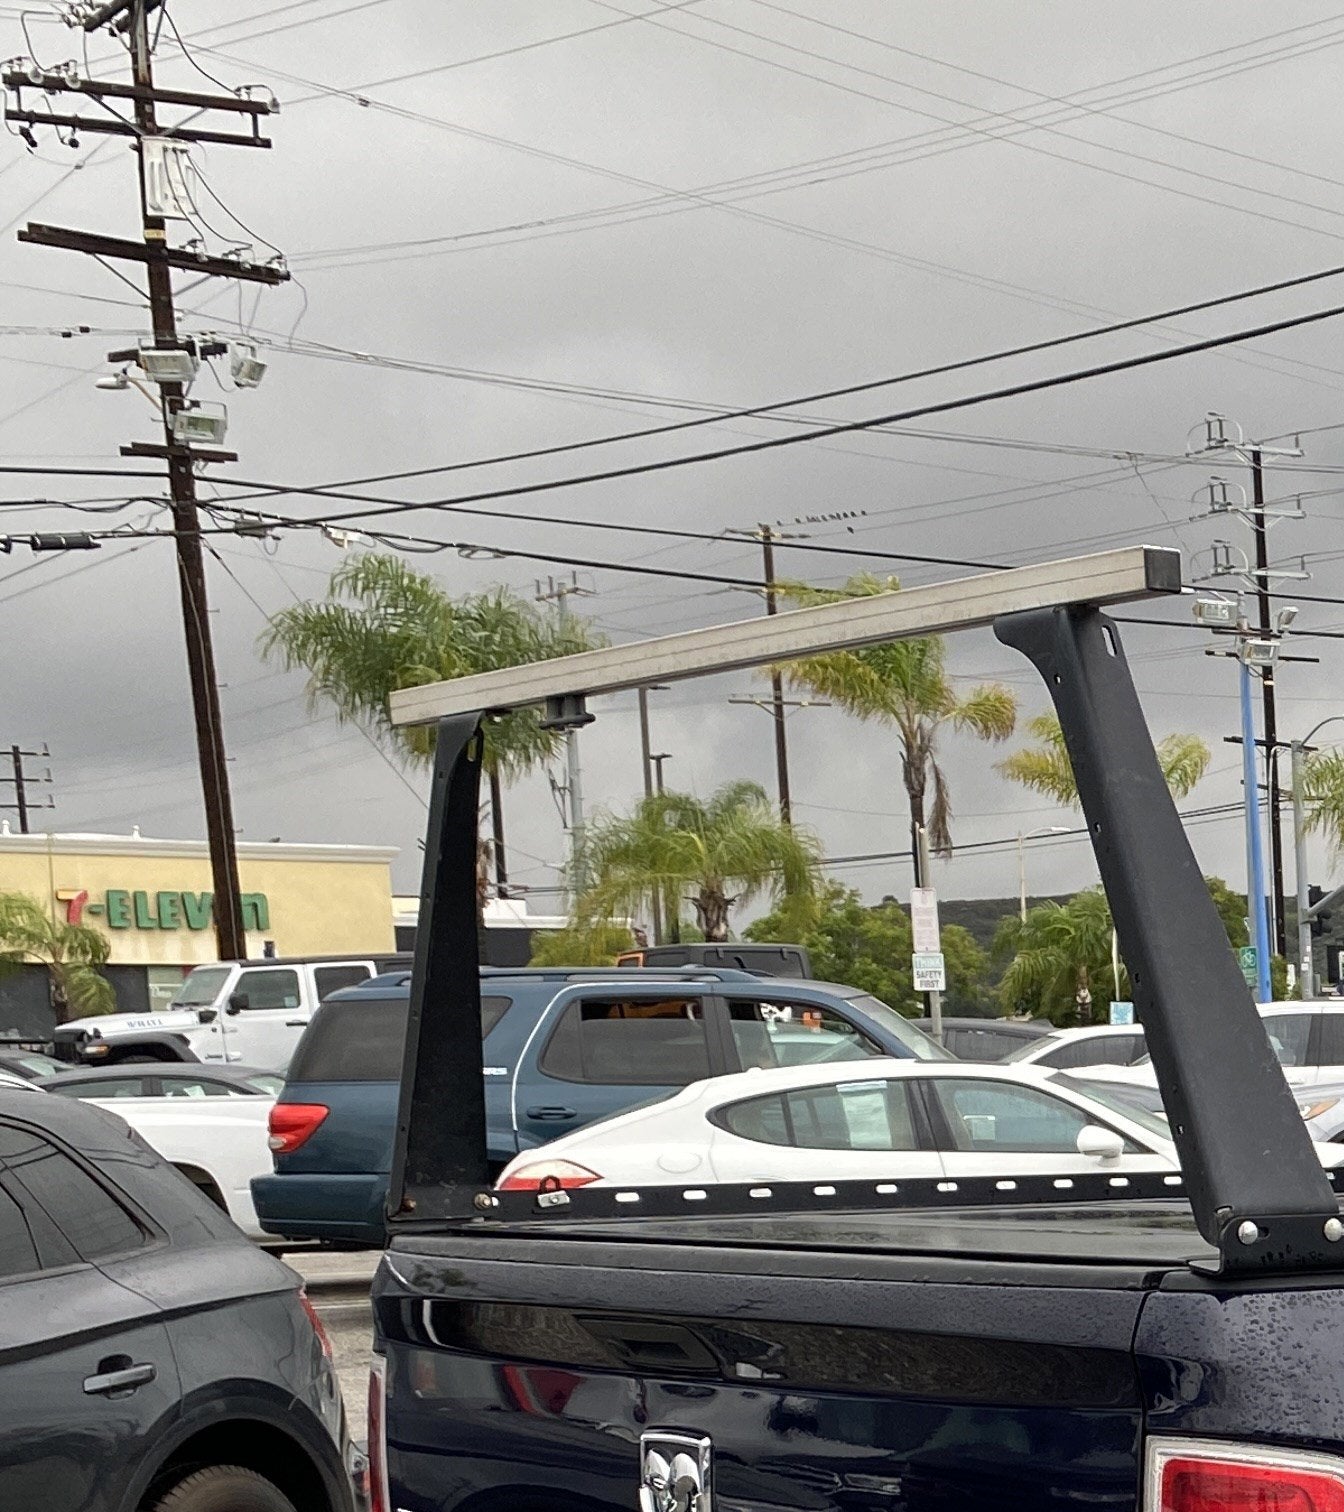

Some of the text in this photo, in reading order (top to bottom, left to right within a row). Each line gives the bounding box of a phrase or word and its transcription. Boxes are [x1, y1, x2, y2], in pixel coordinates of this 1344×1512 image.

[56, 889, 271, 930] 7-ELEVn
[916, 970, 942, 979] SAFETY
[919, 980, 940, 988] FIRST
